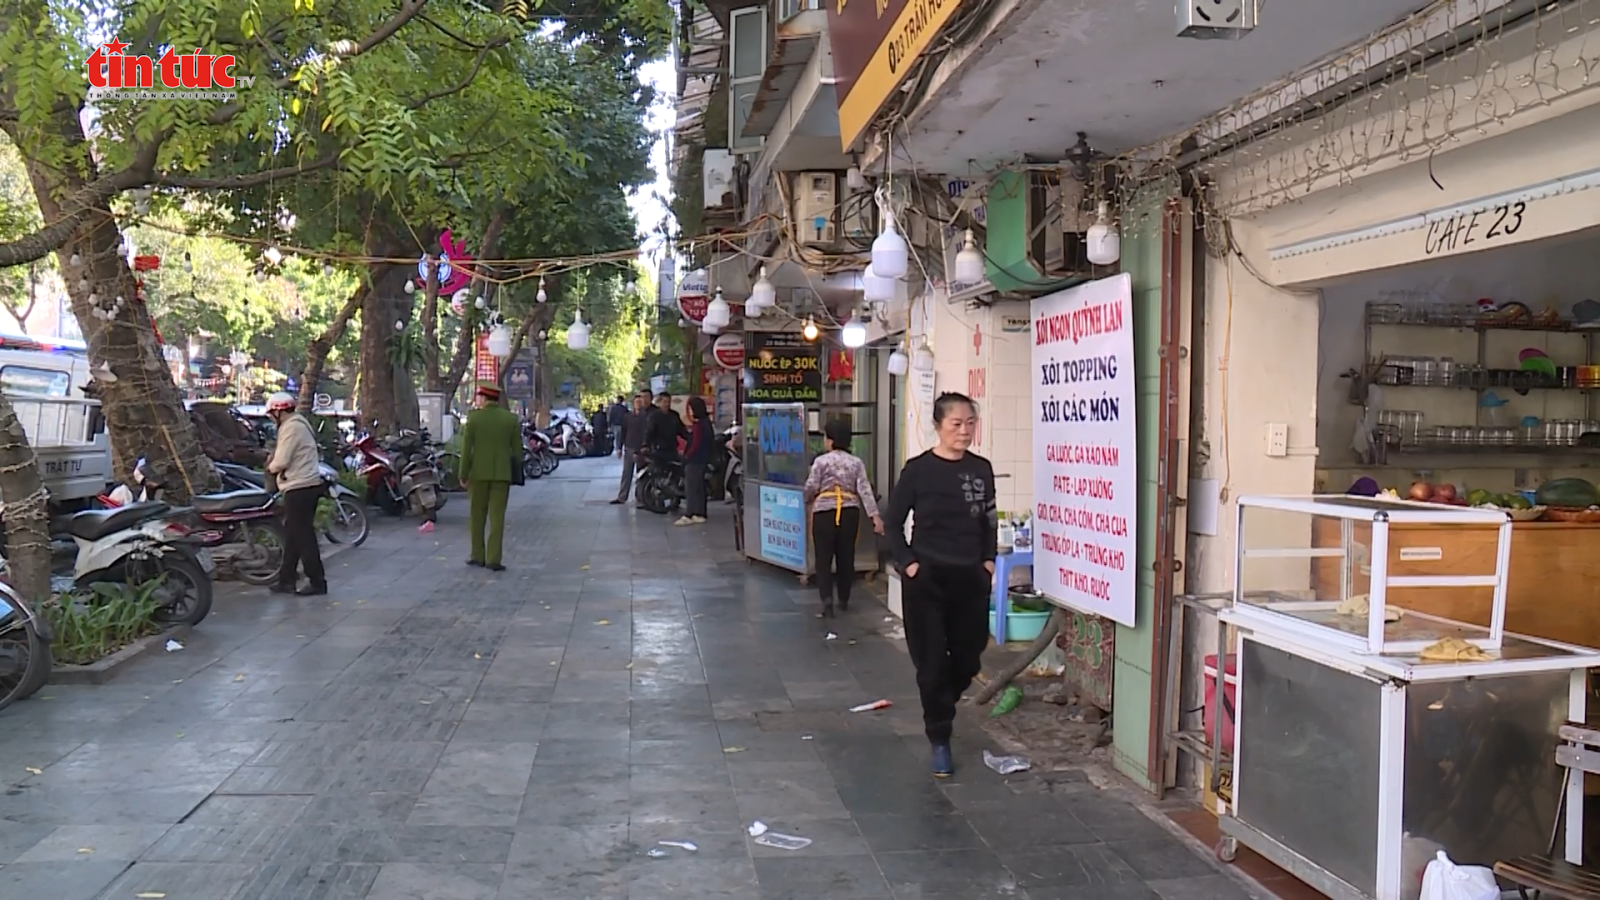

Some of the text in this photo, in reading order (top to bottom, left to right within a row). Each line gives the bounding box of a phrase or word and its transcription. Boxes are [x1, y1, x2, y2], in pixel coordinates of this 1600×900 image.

[1486, 201, 1527, 240] 23
[1049, 312, 1071, 344] NGON
[1103, 300, 1123, 332] LAN
[794, 357, 817, 369] 30K
[1041, 355, 1118, 385] XÔI TOPPING
[763, 374, 787, 384] SINH
[748, 388, 769, 398] HOA
[1041, 392, 1119, 422] XÔI CÁC MÓN
[1109, 549, 1125, 571] KHO
